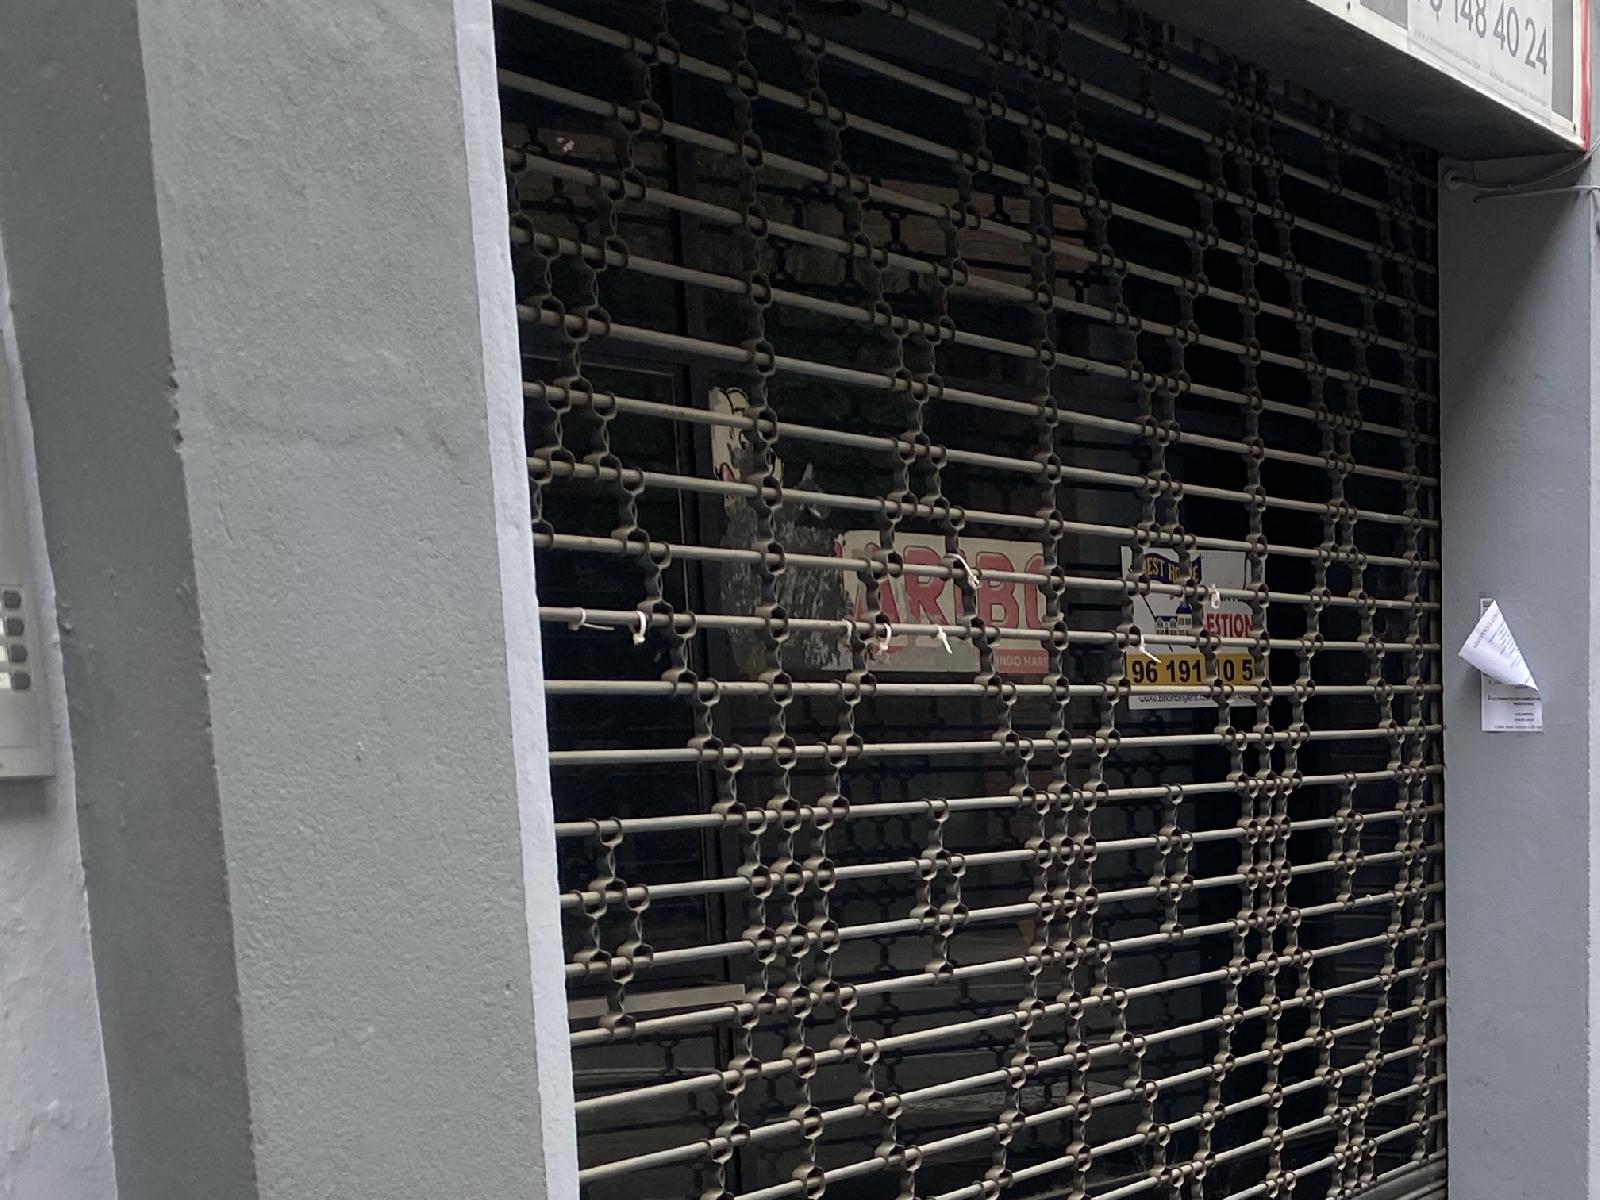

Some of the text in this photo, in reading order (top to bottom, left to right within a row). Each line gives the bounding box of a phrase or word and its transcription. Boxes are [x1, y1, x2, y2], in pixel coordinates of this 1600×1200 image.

[1493, 1, 1519, 58] 40
[1524, 17, 1548, 75] 24
[1142, 556, 1165, 578] EST
[1204, 612, 1254, 638] ESTION
[1131, 660, 1158, 683] 96
[1166, 659, 1202, 684] 191
